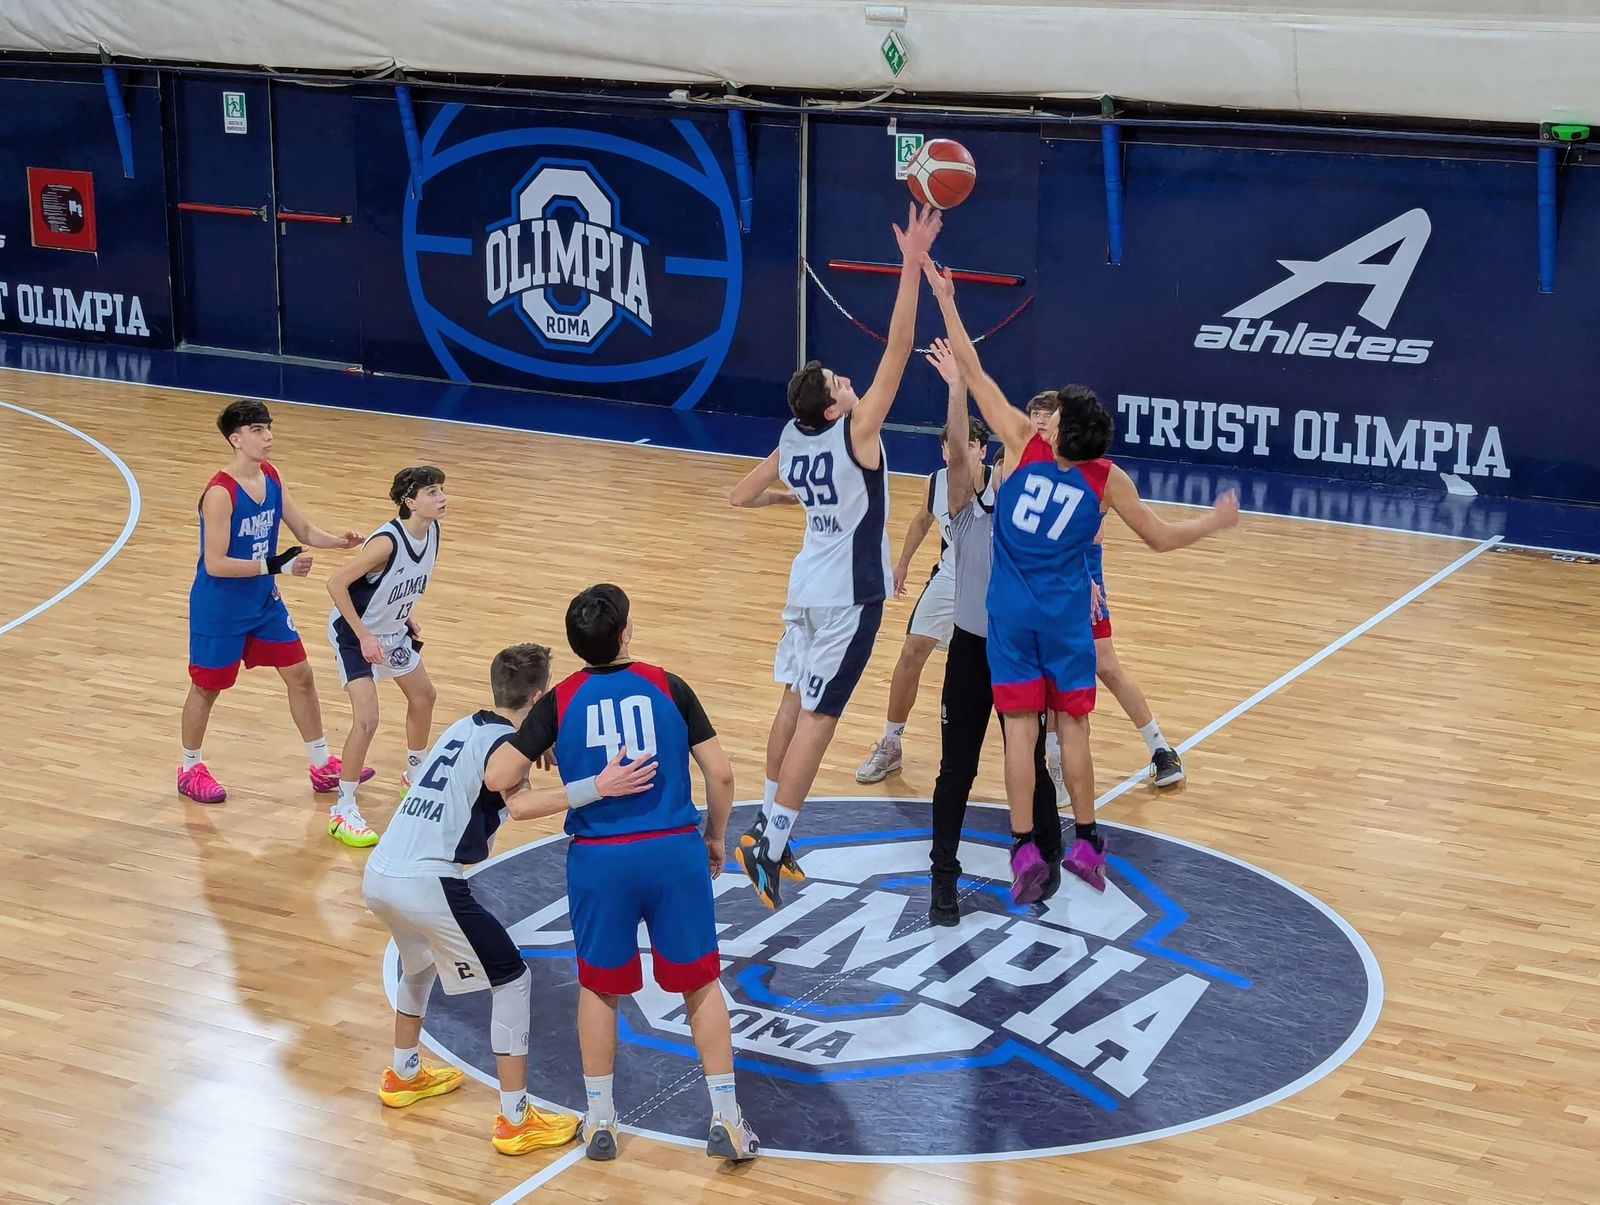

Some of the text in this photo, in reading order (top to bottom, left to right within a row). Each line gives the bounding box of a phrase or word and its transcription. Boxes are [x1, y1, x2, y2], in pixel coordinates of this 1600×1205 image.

[486, 219, 652, 327] OLIMPIA
[17, 284, 150, 336] OLIMPIA
[546, 316, 590, 337] ROMA
[1194, 319, 1434, 364] athletes
[1118, 395, 1511, 478] TRUST OLIMPIA
[788, 451, 838, 507] 99
[1012, 473, 1084, 540] 27
[395, 601, 413, 620] 13
[586, 694, 657, 765] 40
[418, 739, 465, 792] 2
[455, 962, 475, 980] 2
[659, 1008, 856, 1059] OMA
